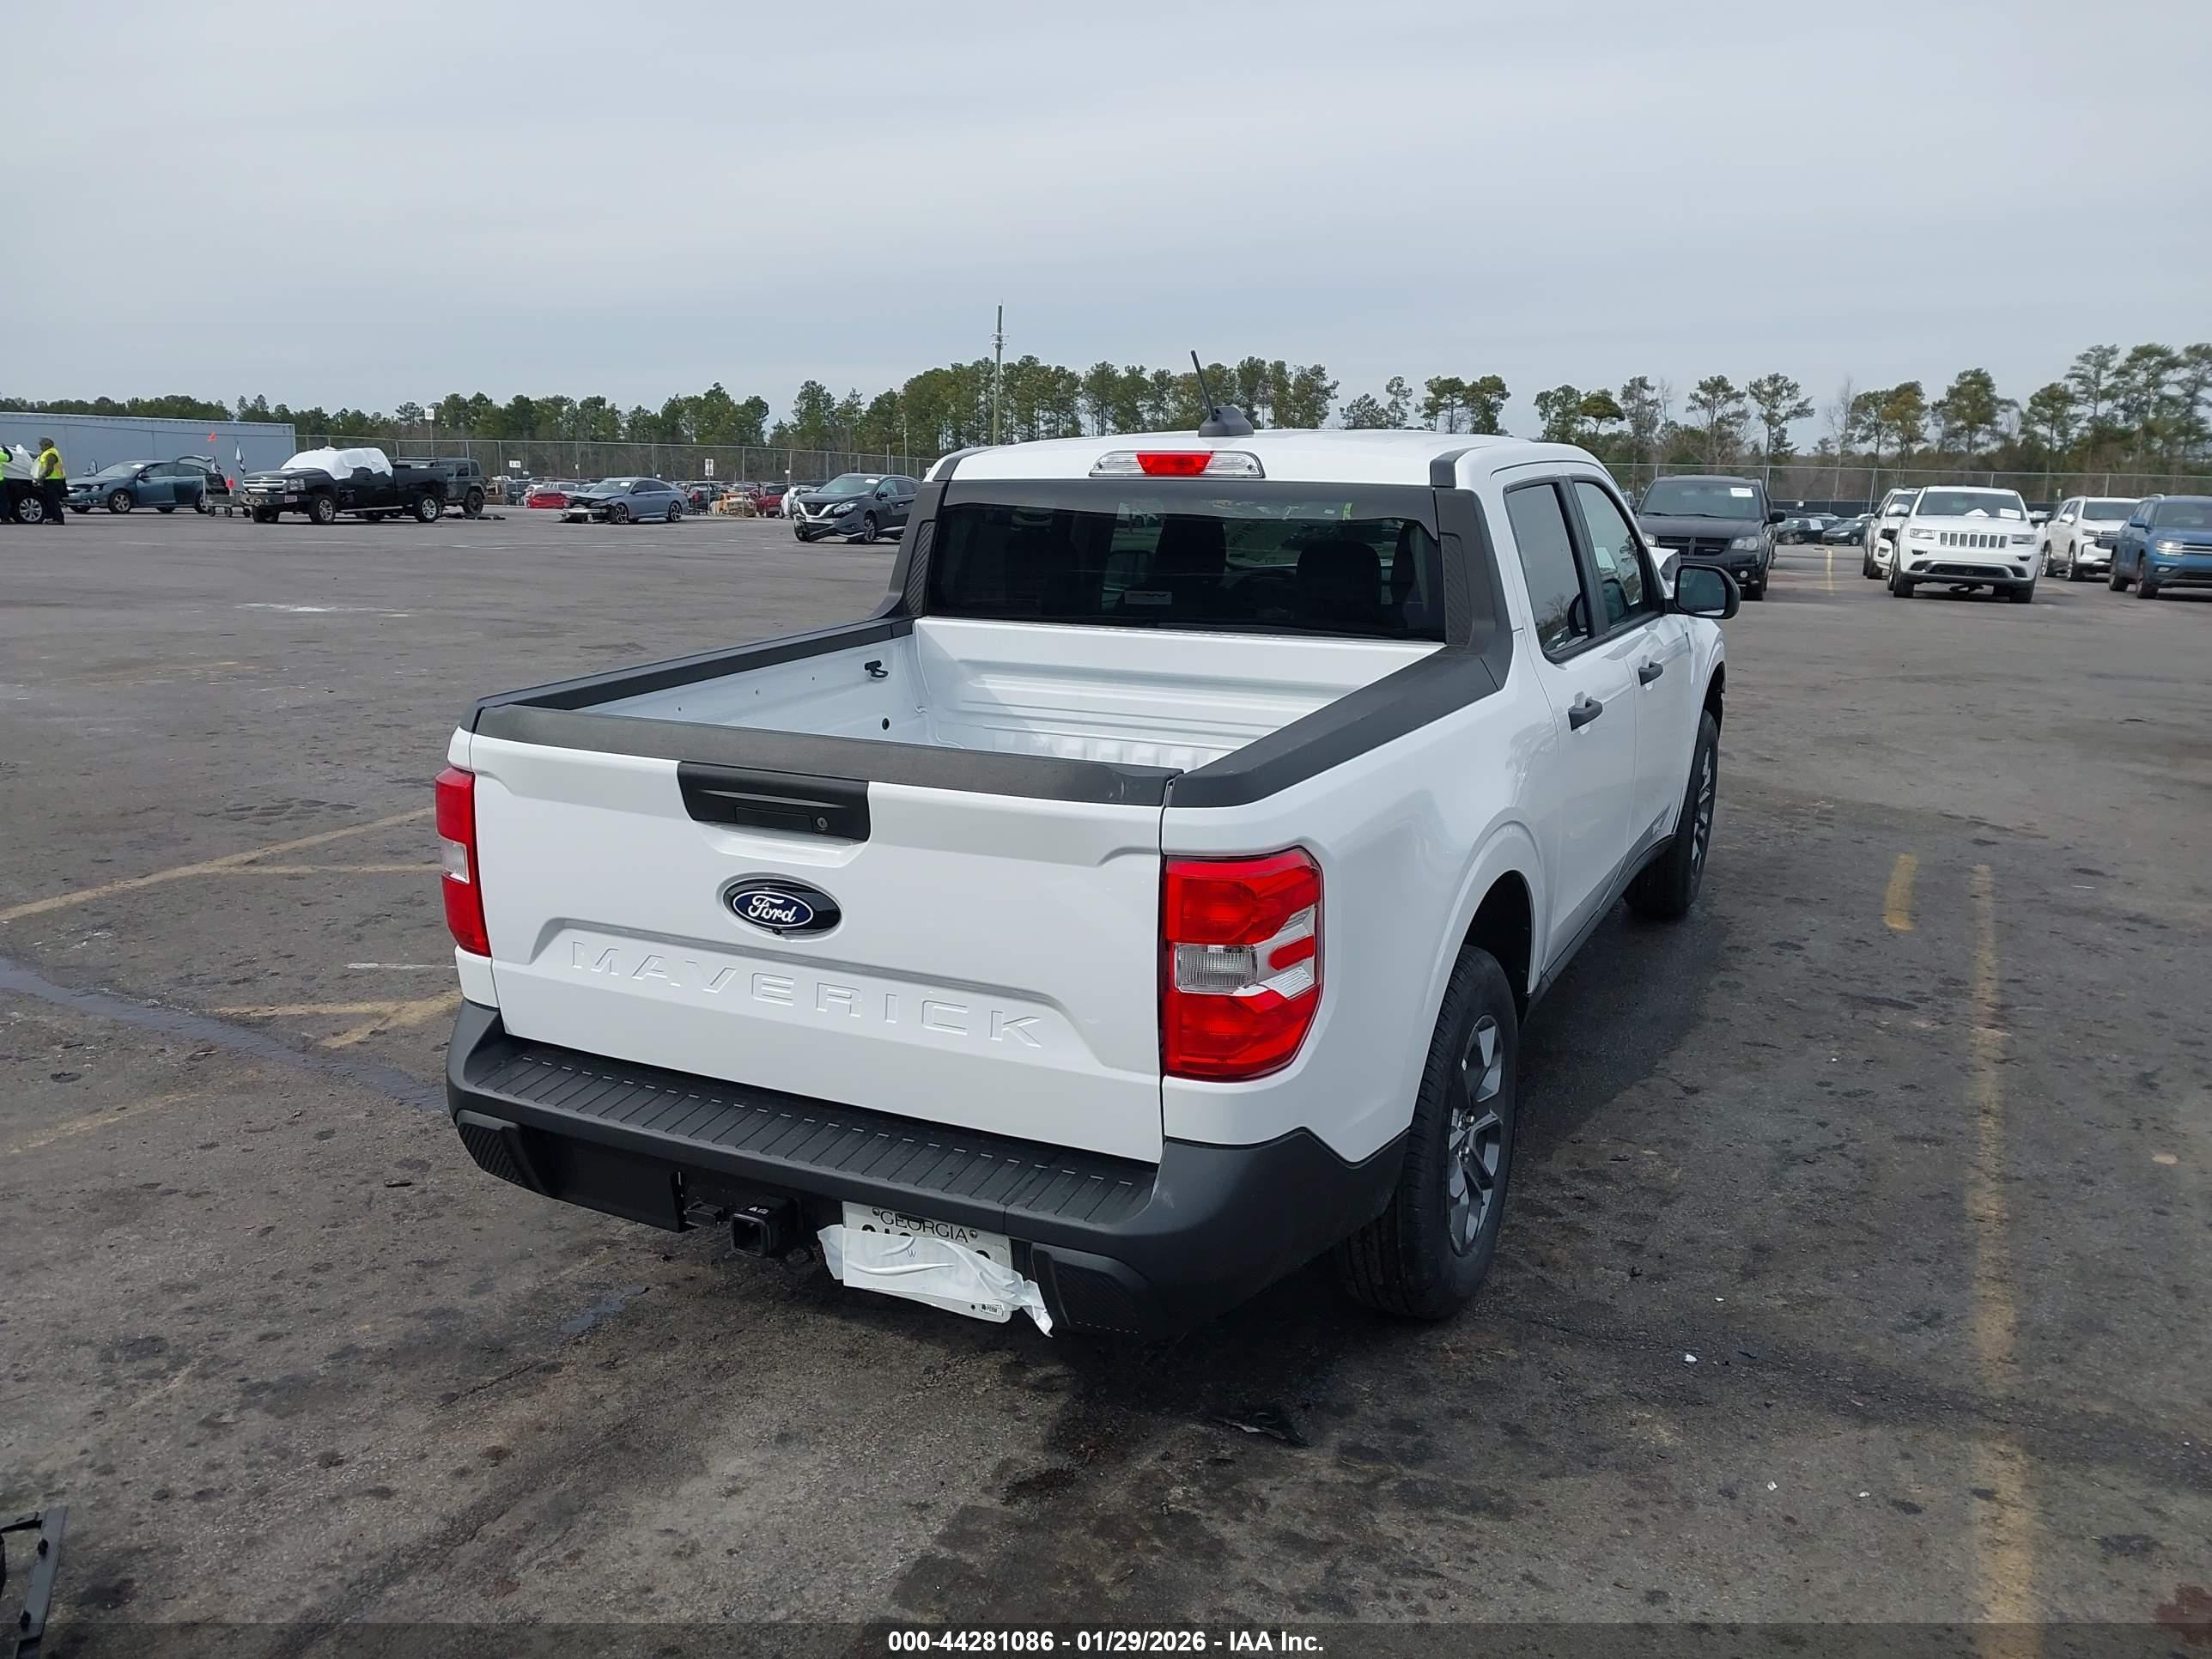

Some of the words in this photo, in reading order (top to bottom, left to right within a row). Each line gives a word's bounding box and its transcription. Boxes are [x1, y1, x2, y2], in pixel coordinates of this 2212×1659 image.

[748, 892, 799, 924] Ford
[571, 939, 1042, 1049] MAVERICK
[880, 1210, 969, 1243] GEORGIA
